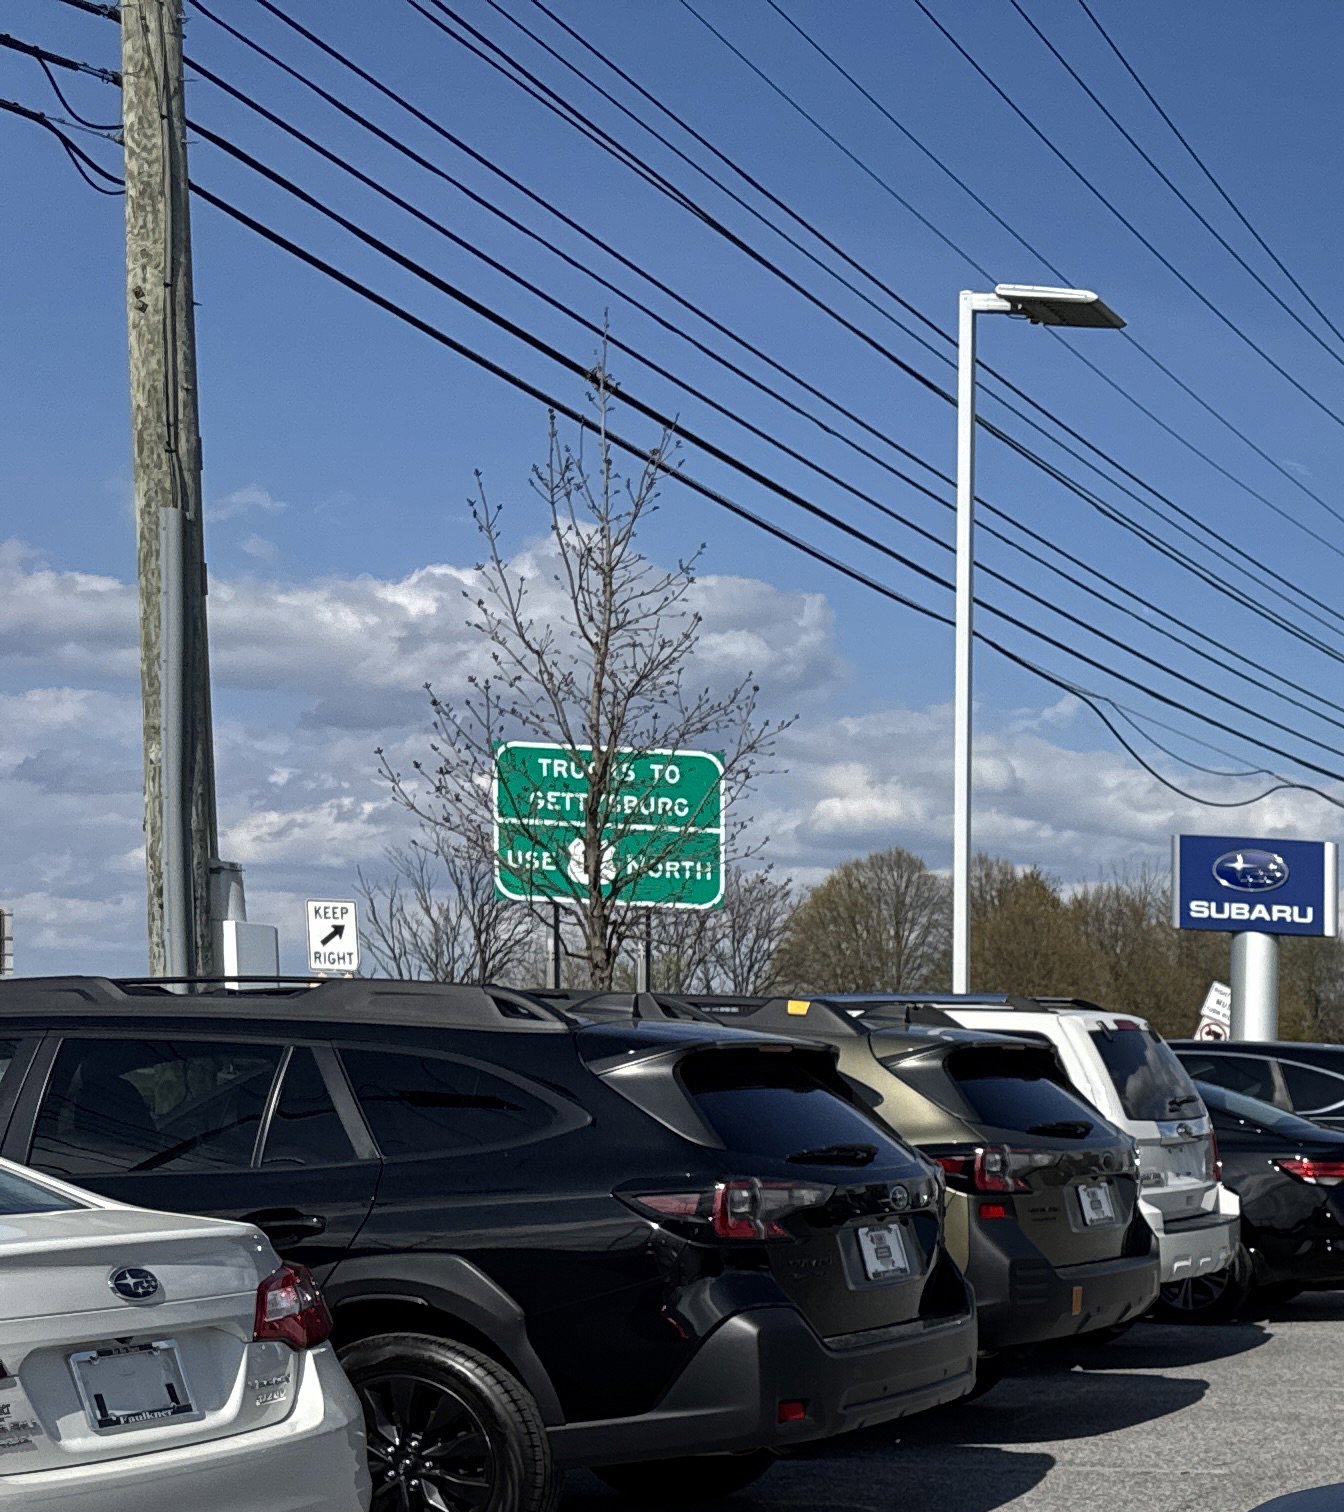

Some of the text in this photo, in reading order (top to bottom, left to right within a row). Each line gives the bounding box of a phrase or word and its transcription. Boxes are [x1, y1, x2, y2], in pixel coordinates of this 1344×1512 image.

[650, 764, 681, 784] TO
[507, 849, 557, 871] USE
[314, 906, 349, 920] KEEP
[1189, 900, 1314, 924] SUBARU
[314, 951, 354, 966] RIGHT
[119, 1408, 174, 1424] Faulkner
